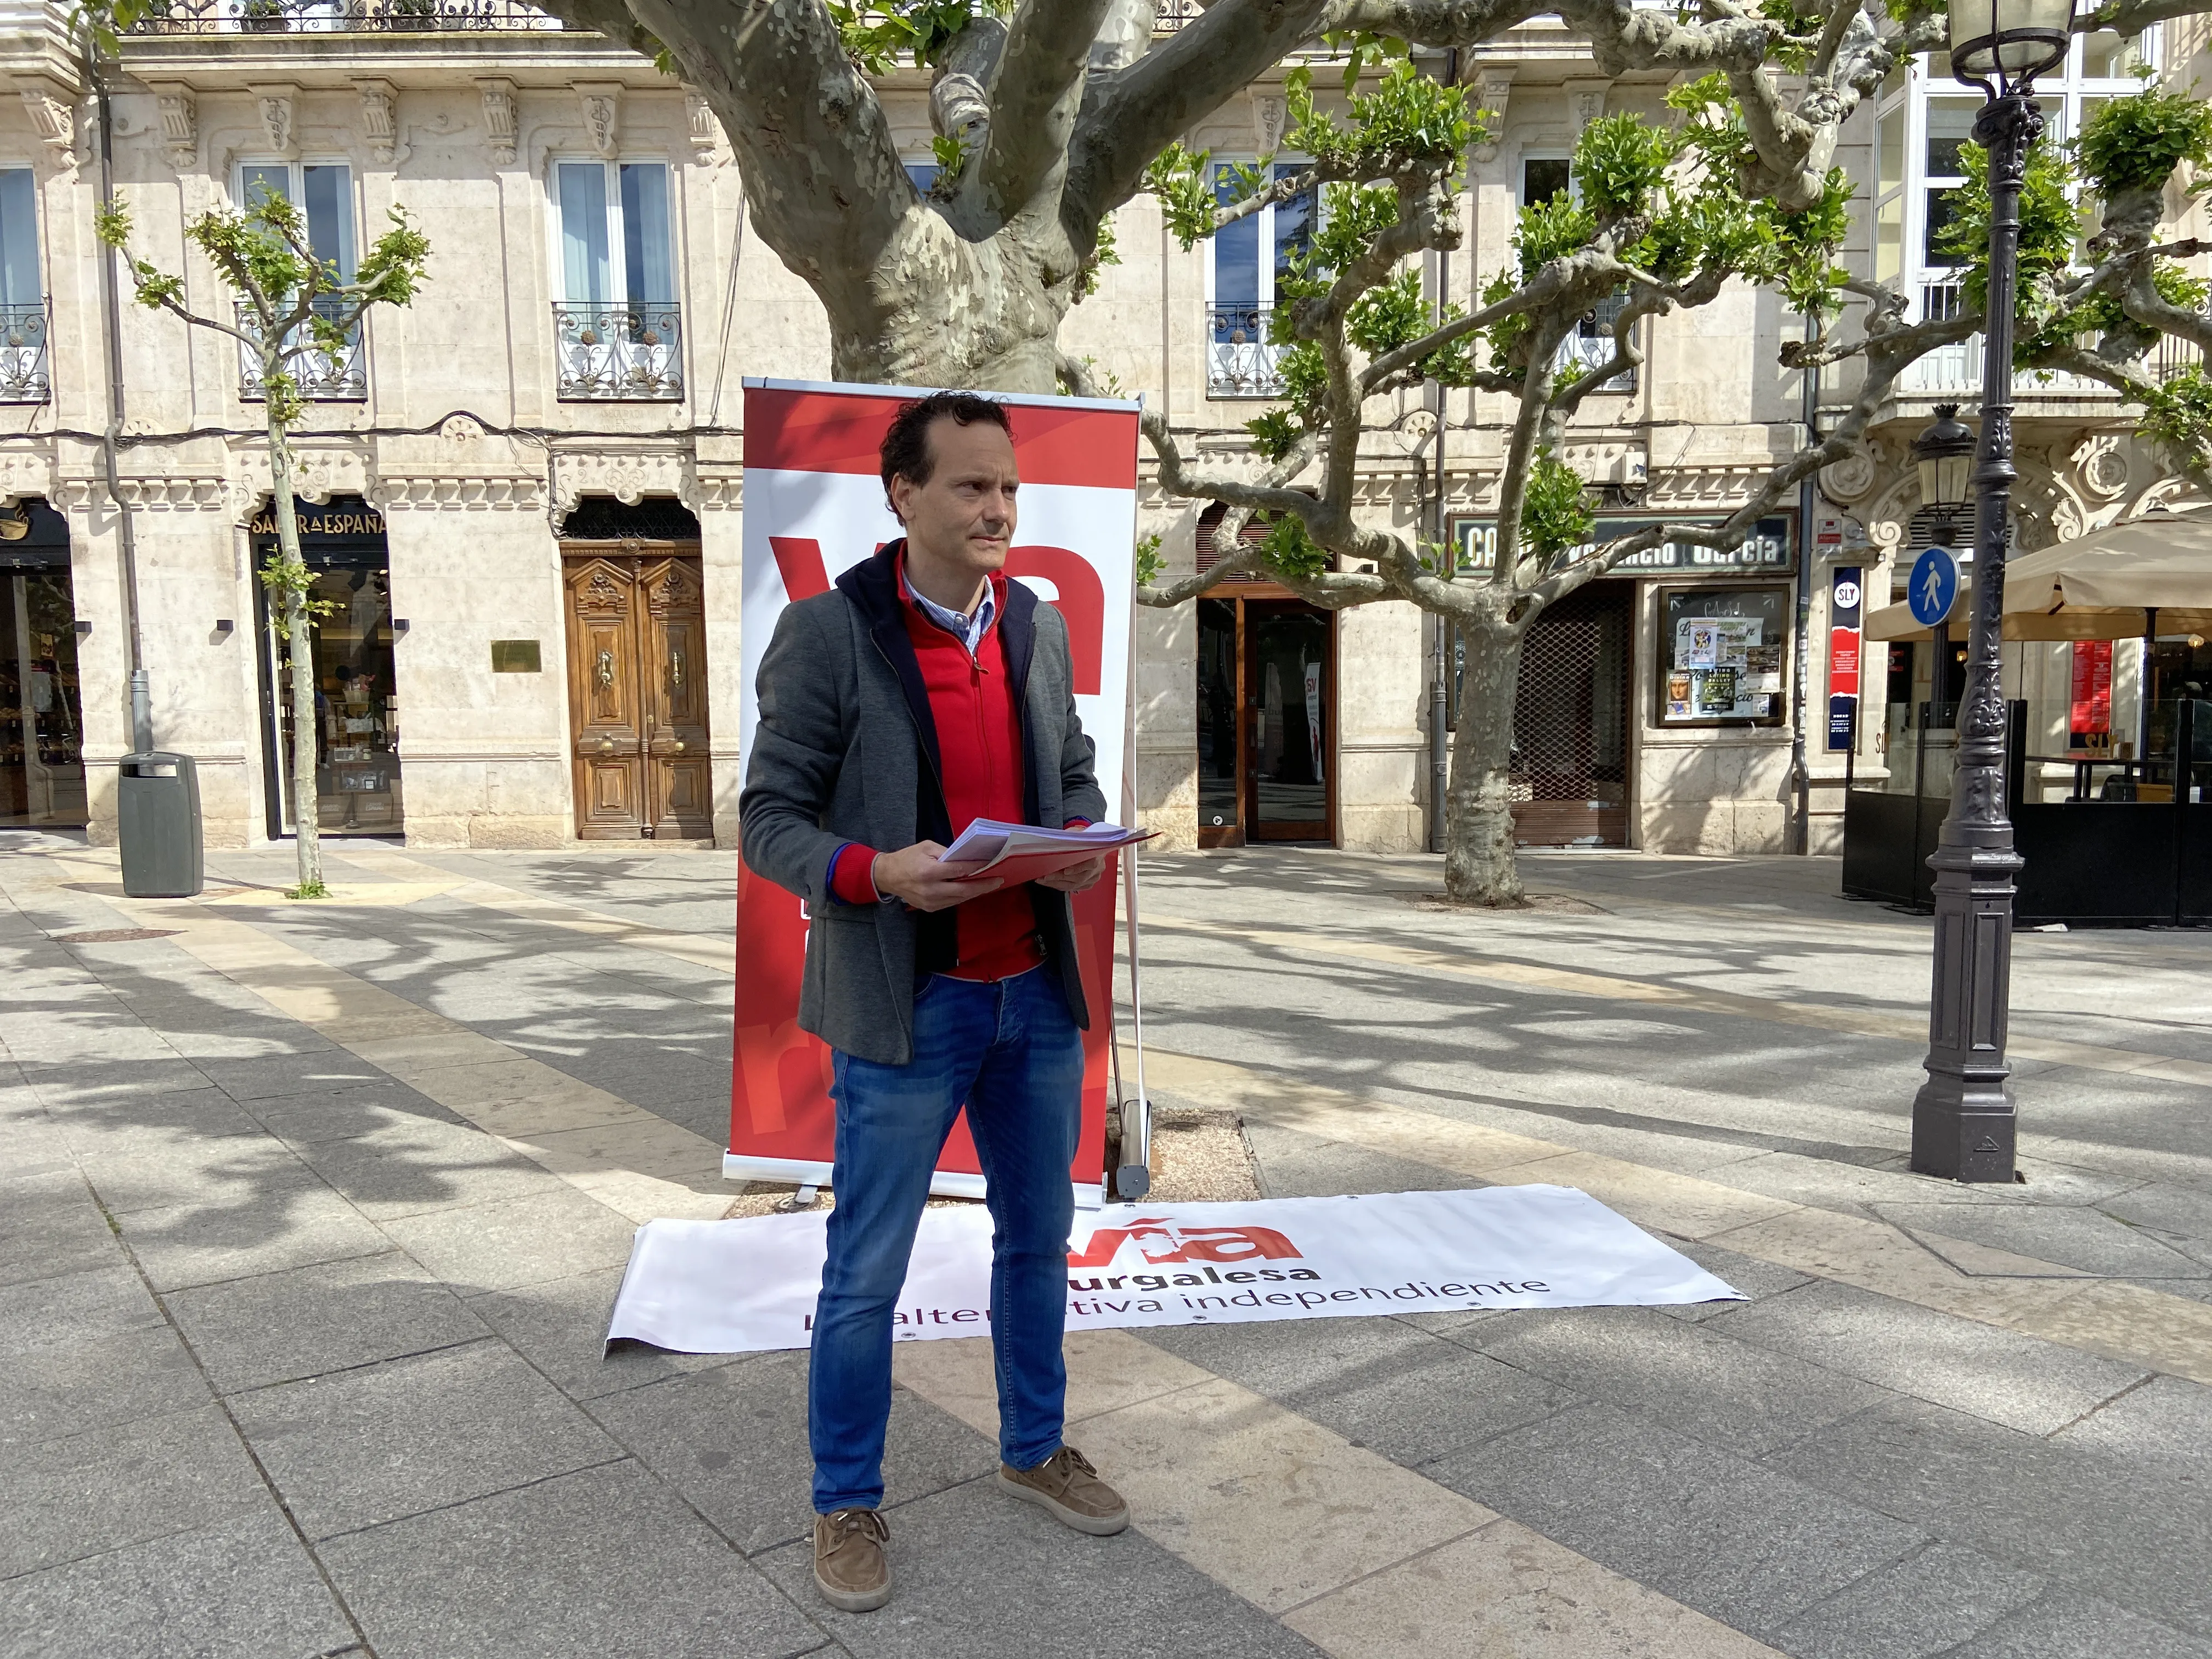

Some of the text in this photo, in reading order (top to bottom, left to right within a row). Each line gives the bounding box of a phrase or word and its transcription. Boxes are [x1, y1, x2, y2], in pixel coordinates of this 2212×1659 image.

[252, 514, 309, 533] SAR
[311, 516, 323, 531] A
[1839, 589, 1855, 601] SLY
[2085, 733, 2119, 758] SLY
[1068, 1267, 1322, 1291] urgalesa
[1180, 1280, 1551, 1310] independiente
